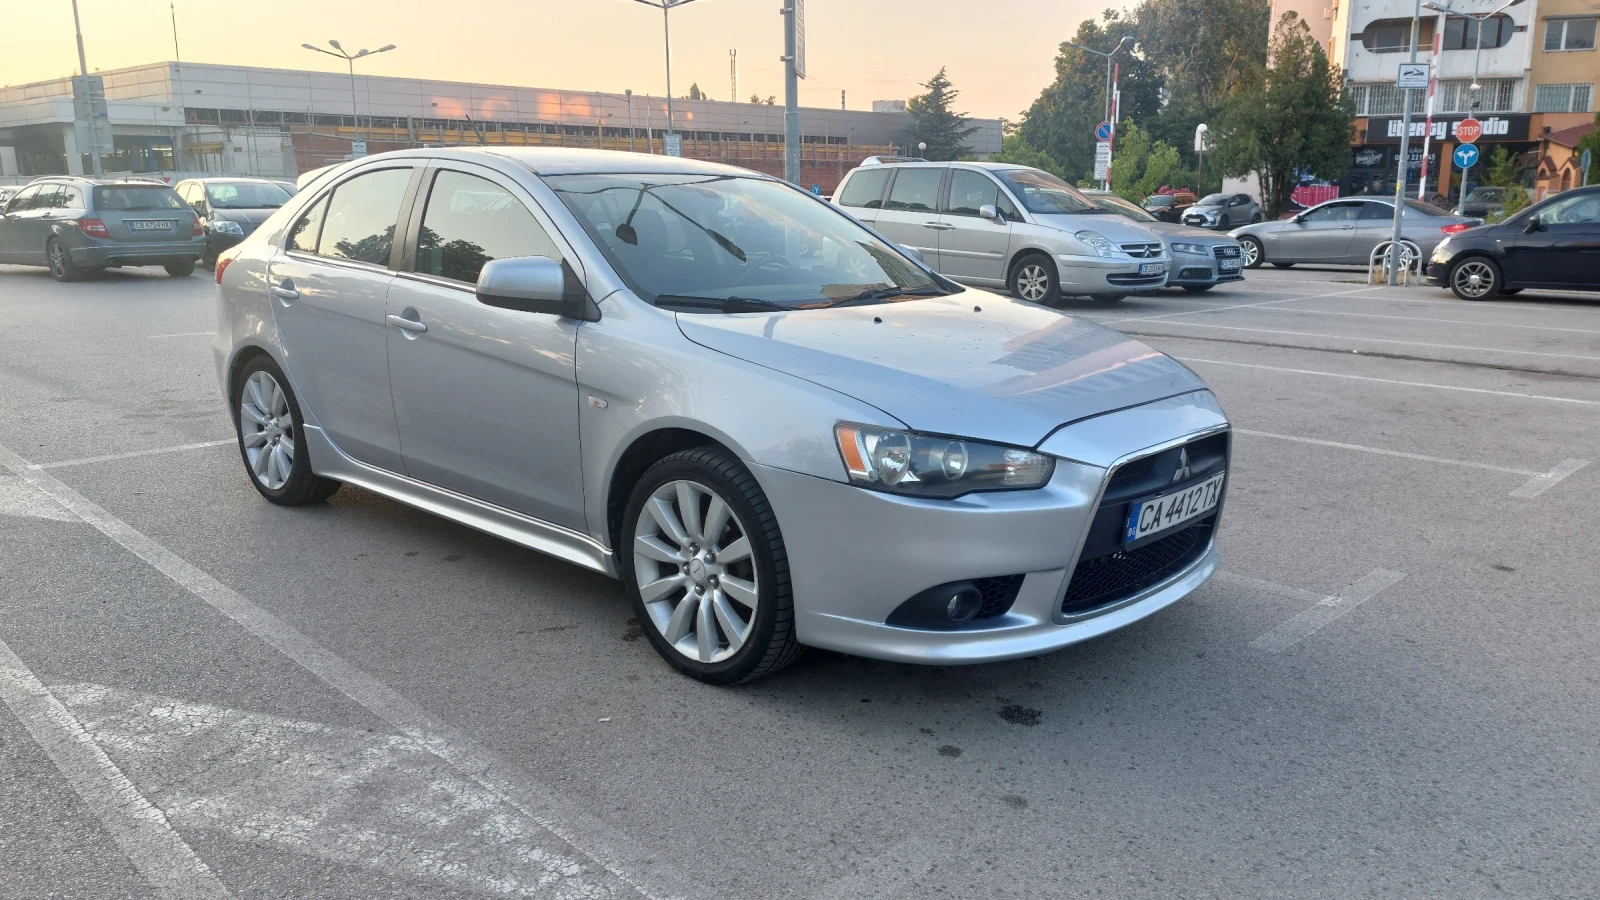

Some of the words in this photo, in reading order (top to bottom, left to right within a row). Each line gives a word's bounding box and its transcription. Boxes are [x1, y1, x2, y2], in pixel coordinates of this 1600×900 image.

[1458, 126, 1479, 136] STOP
[1140, 501, 1163, 532] CA
[1165, 487, 1203, 523] 4412
[1202, 477, 1222, 509] TX
[1127, 526, 1137, 537] BG
